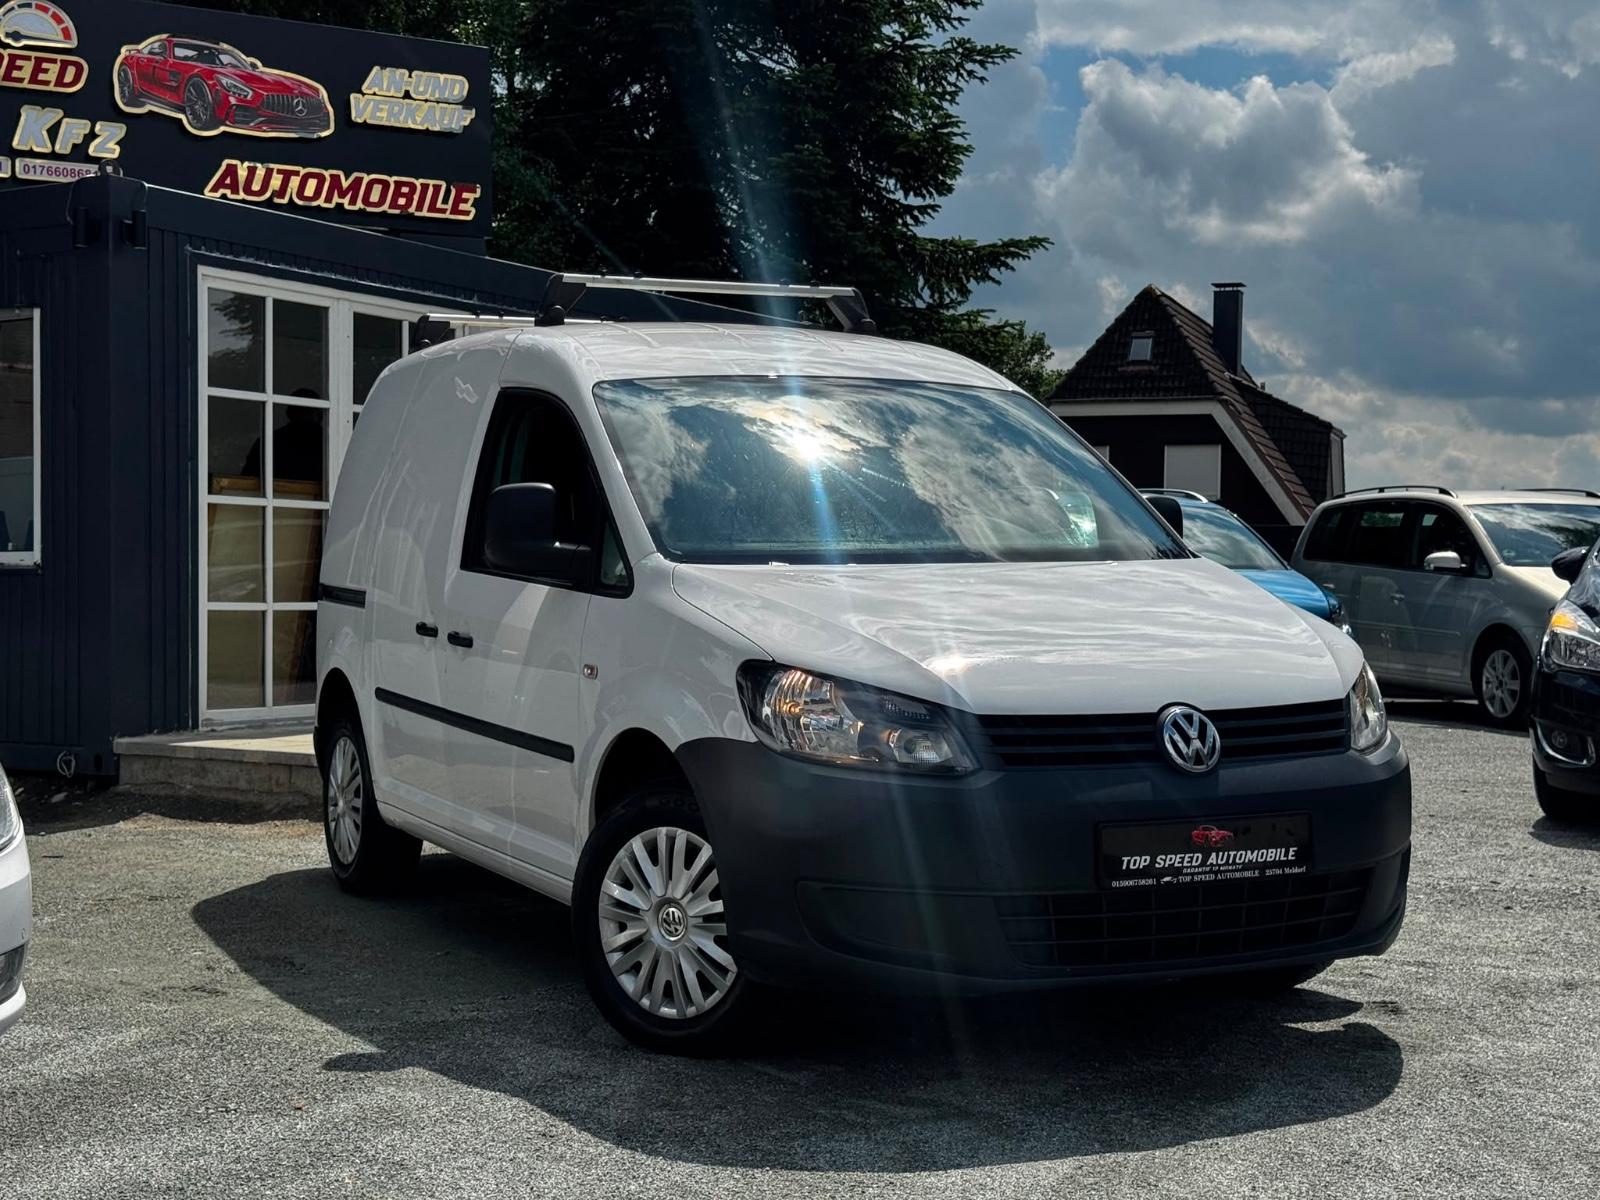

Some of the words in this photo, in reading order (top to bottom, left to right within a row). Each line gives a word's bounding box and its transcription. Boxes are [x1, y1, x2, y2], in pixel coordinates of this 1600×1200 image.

[0, 52, 86, 90] EED
[364, 67, 468, 102] AN-UND
[351, 94, 475, 132] VERKAUF
[206, 161, 480, 218] AUTOMOBILE
[1121, 856, 1150, 870] TOP
[1155, 853, 1202, 868] SPEED
[1206, 847, 1298, 865] AUTOMOBILE
[1178, 875, 1192, 883] TOP
[1193, 873, 1215, 882] SPEED
[1216, 869, 1260, 880] AUTOMOBILE
